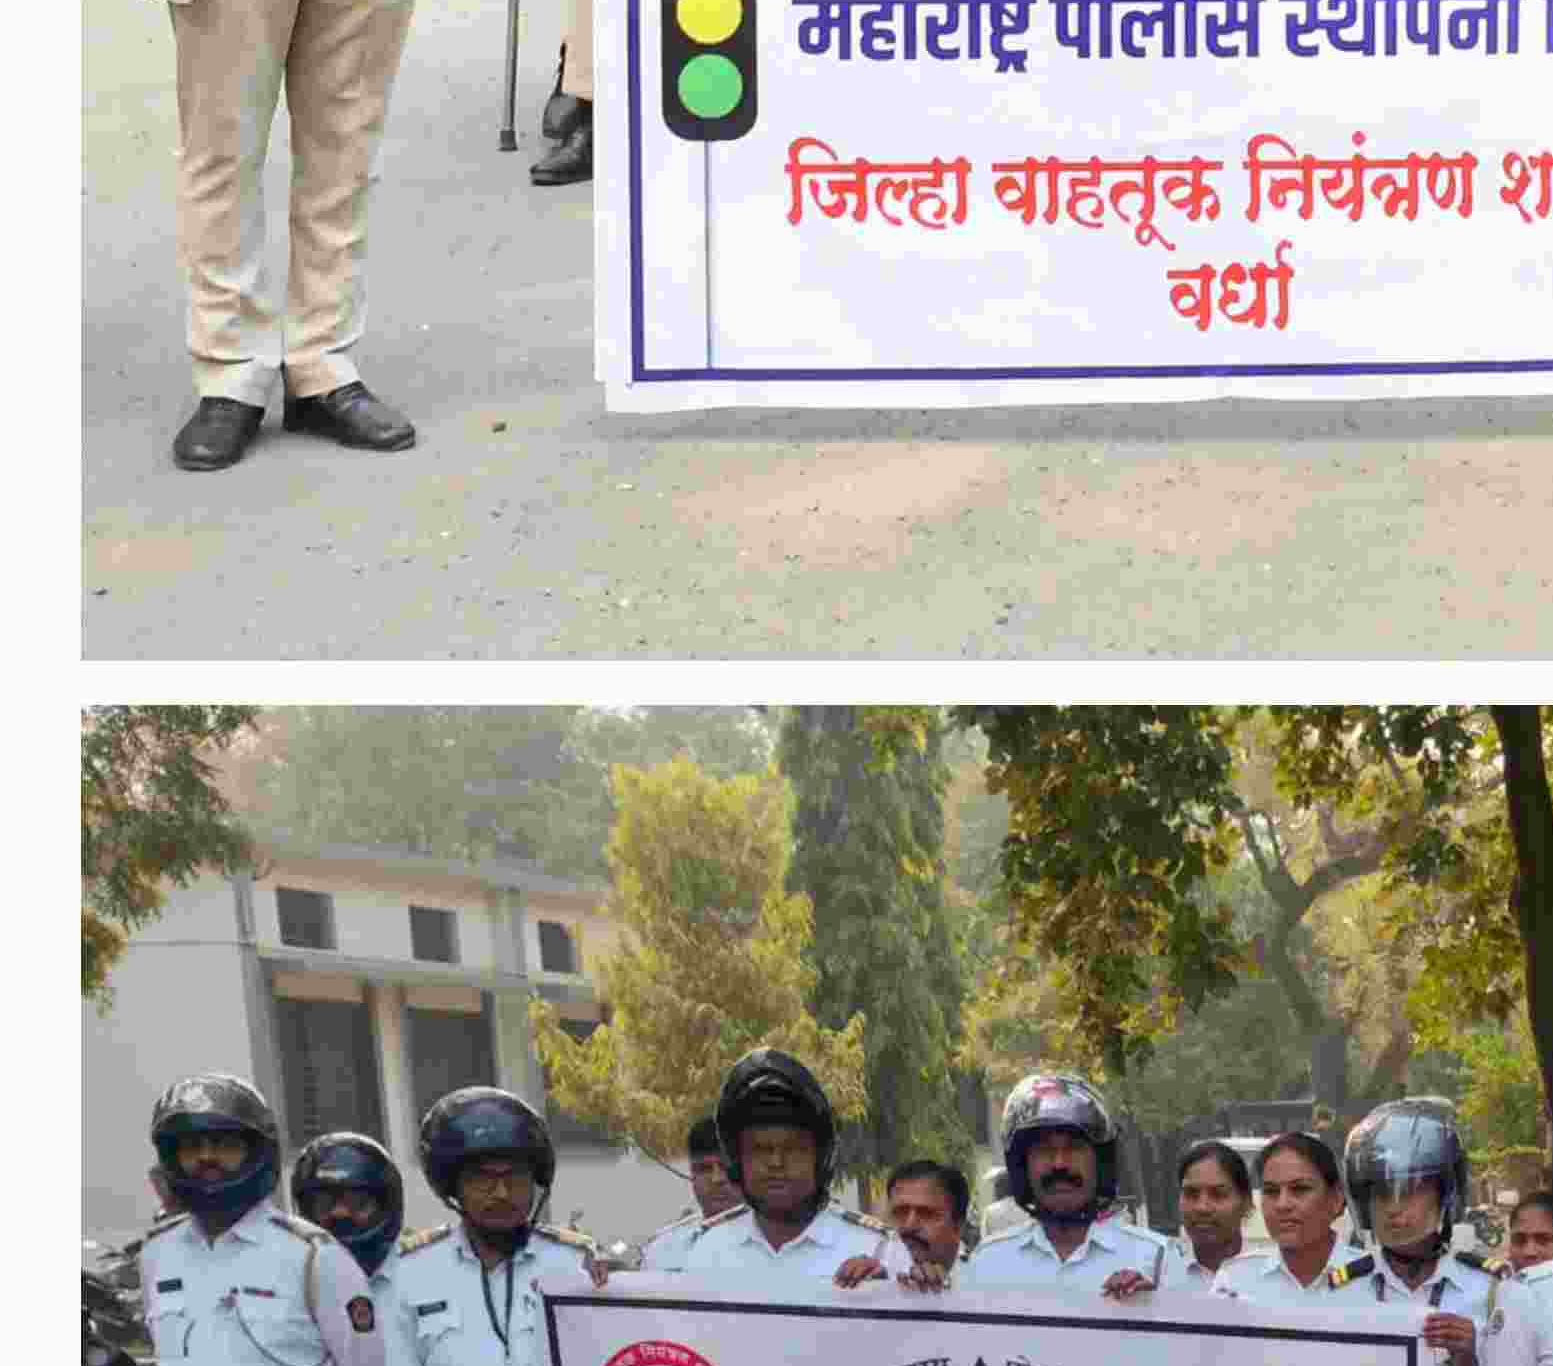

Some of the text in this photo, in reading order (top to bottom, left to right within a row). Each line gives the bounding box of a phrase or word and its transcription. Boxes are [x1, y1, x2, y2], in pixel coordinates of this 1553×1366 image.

[785, 139, 970, 229] जिल्हा
[992, 156, 1223, 251] वाहतूक
[1247, 131, 1476, 219] नियंत्रण
[1168, 241, 1293, 331] वर्धा
